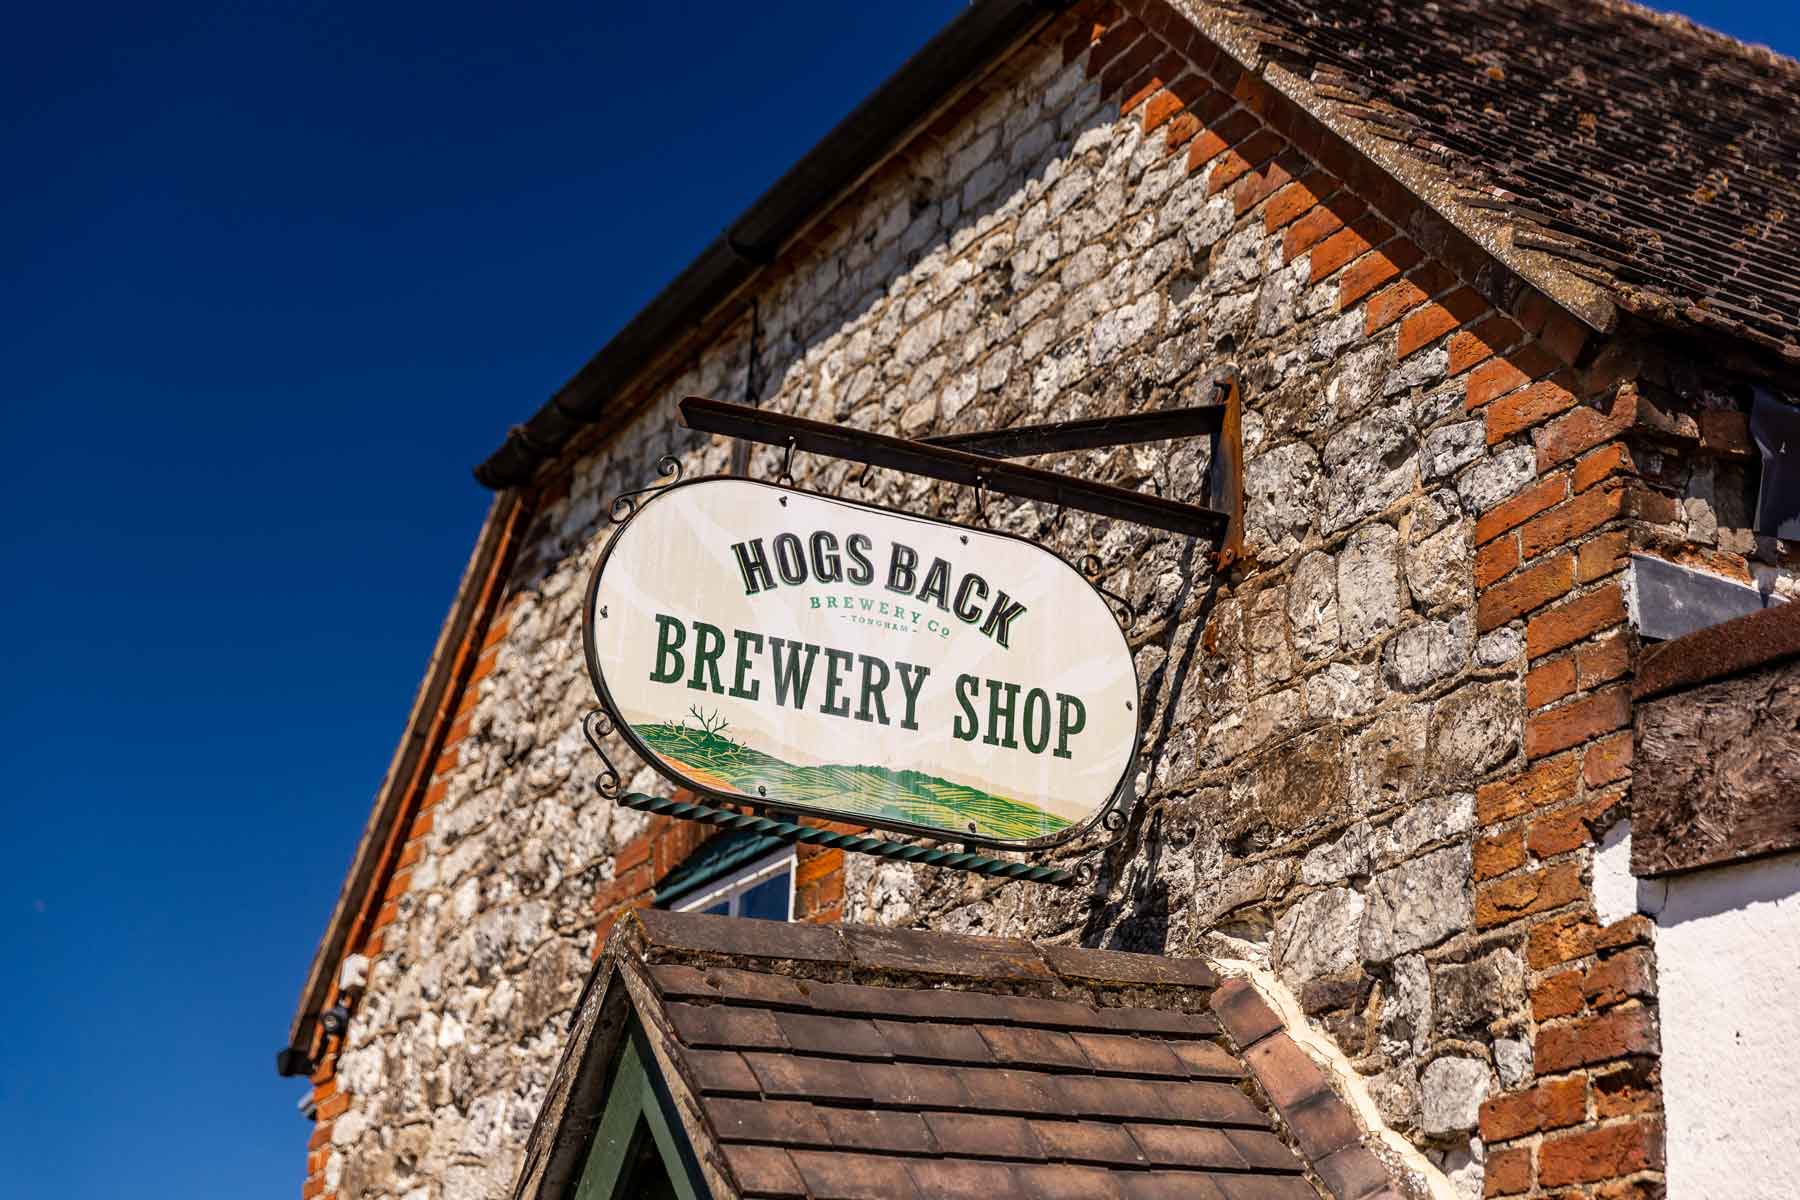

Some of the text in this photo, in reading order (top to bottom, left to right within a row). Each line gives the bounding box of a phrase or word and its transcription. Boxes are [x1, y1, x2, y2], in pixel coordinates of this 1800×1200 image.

[731, 530, 1028, 650] HOGS BACK
[809, 596, 922, 624] BREWERY
[649, 612, 1088, 761] BREWERY SHOP
